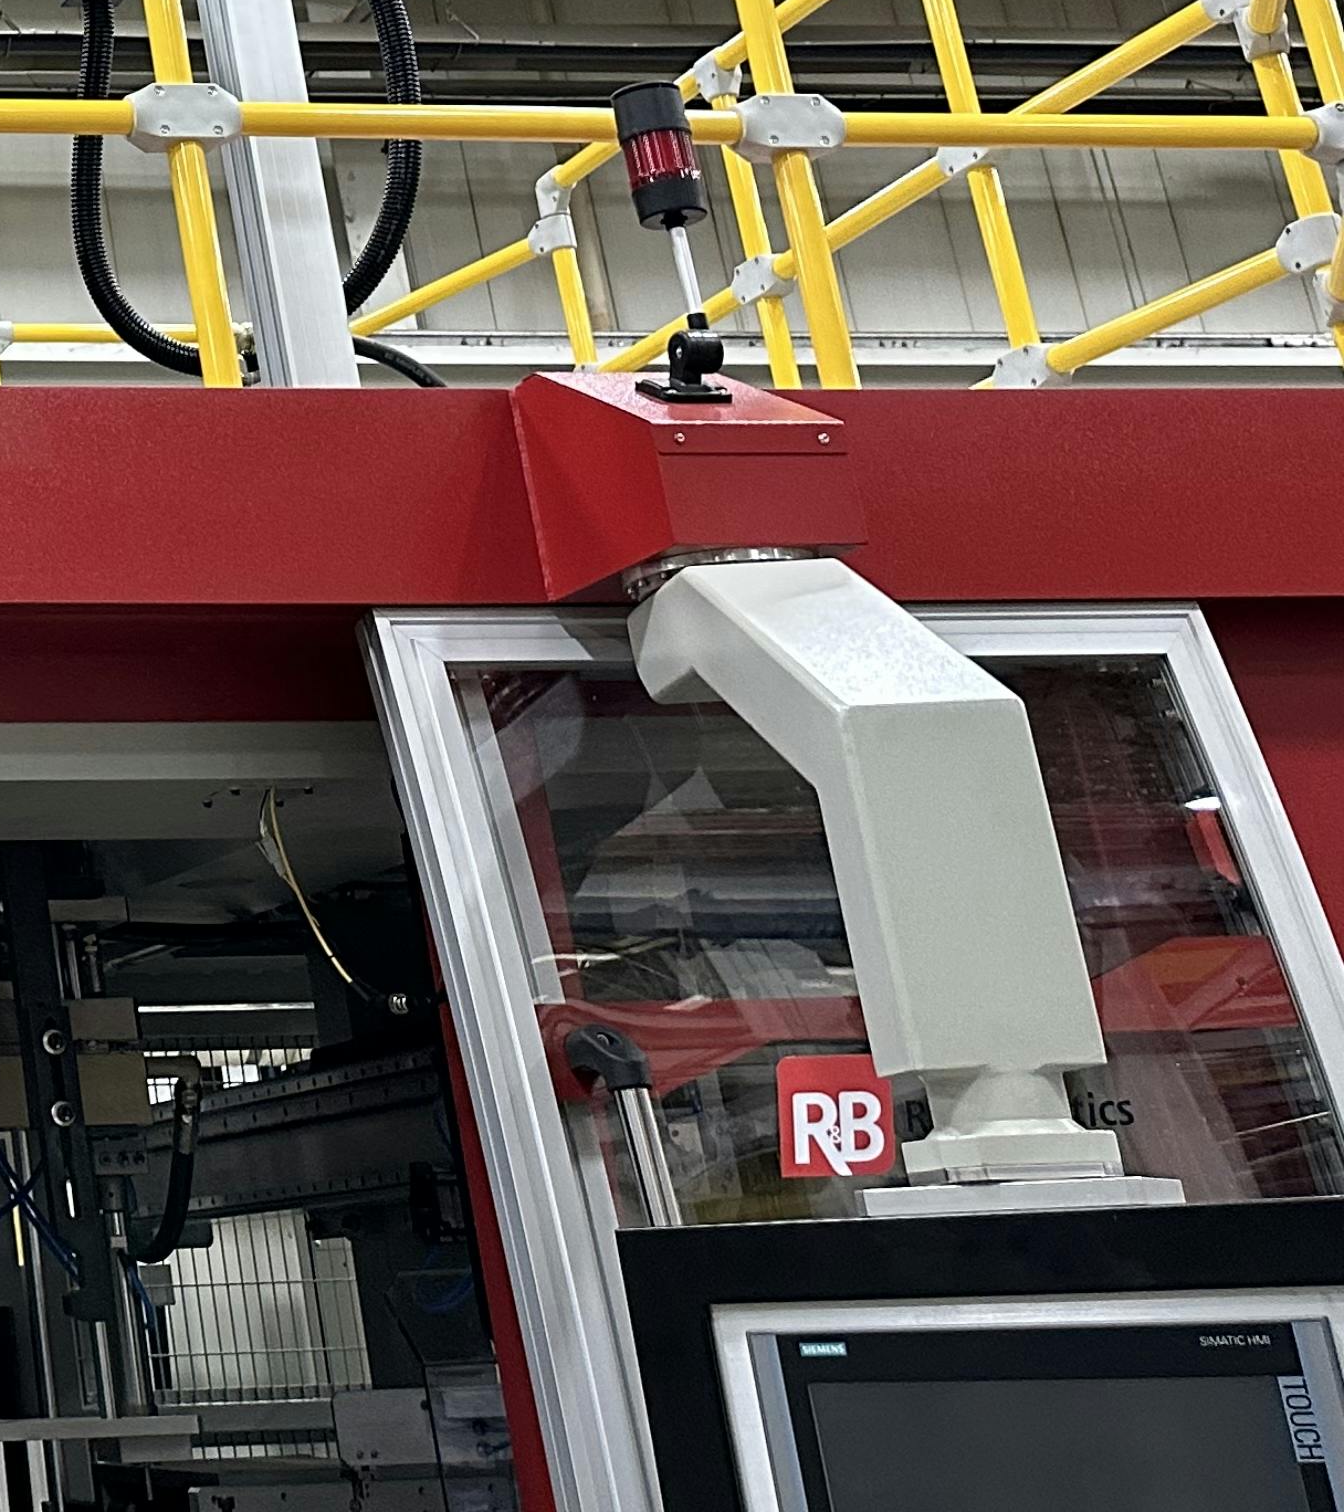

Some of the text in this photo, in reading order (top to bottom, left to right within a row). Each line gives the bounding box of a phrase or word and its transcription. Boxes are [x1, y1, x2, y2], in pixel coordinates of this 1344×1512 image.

[1072, 1091, 1135, 1126] tics
[1199, 1334, 1245, 1346] SIMATIC
[1282, 1378, 1324, 1459] TOUCH
